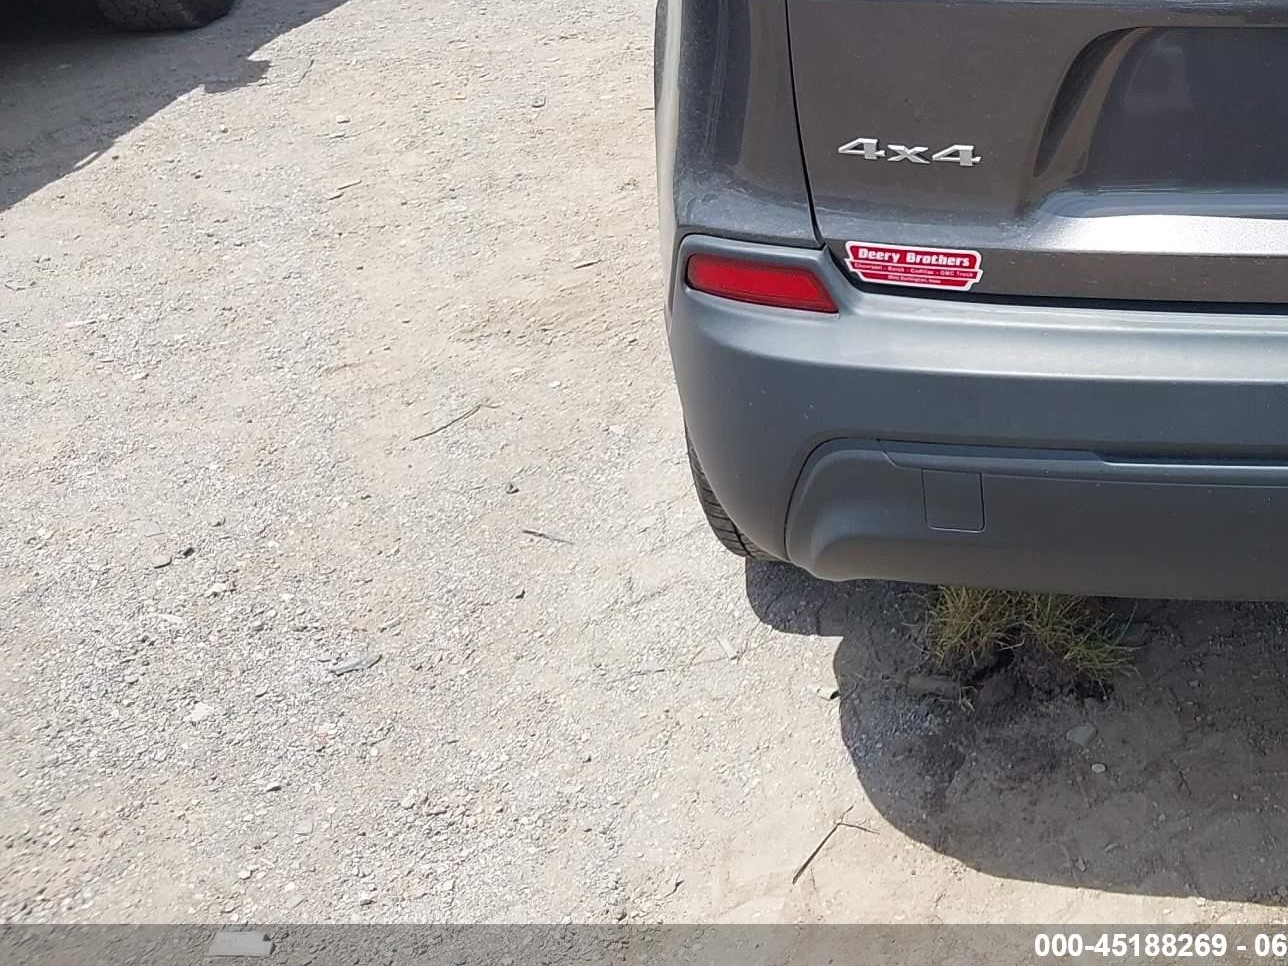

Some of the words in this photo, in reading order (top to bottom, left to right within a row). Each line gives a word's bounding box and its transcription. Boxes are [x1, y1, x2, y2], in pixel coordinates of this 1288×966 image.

[838, 137, 982, 167] 4x4
[858, 247, 900, 263] Deery
[906, 252, 970, 267] Brothers
